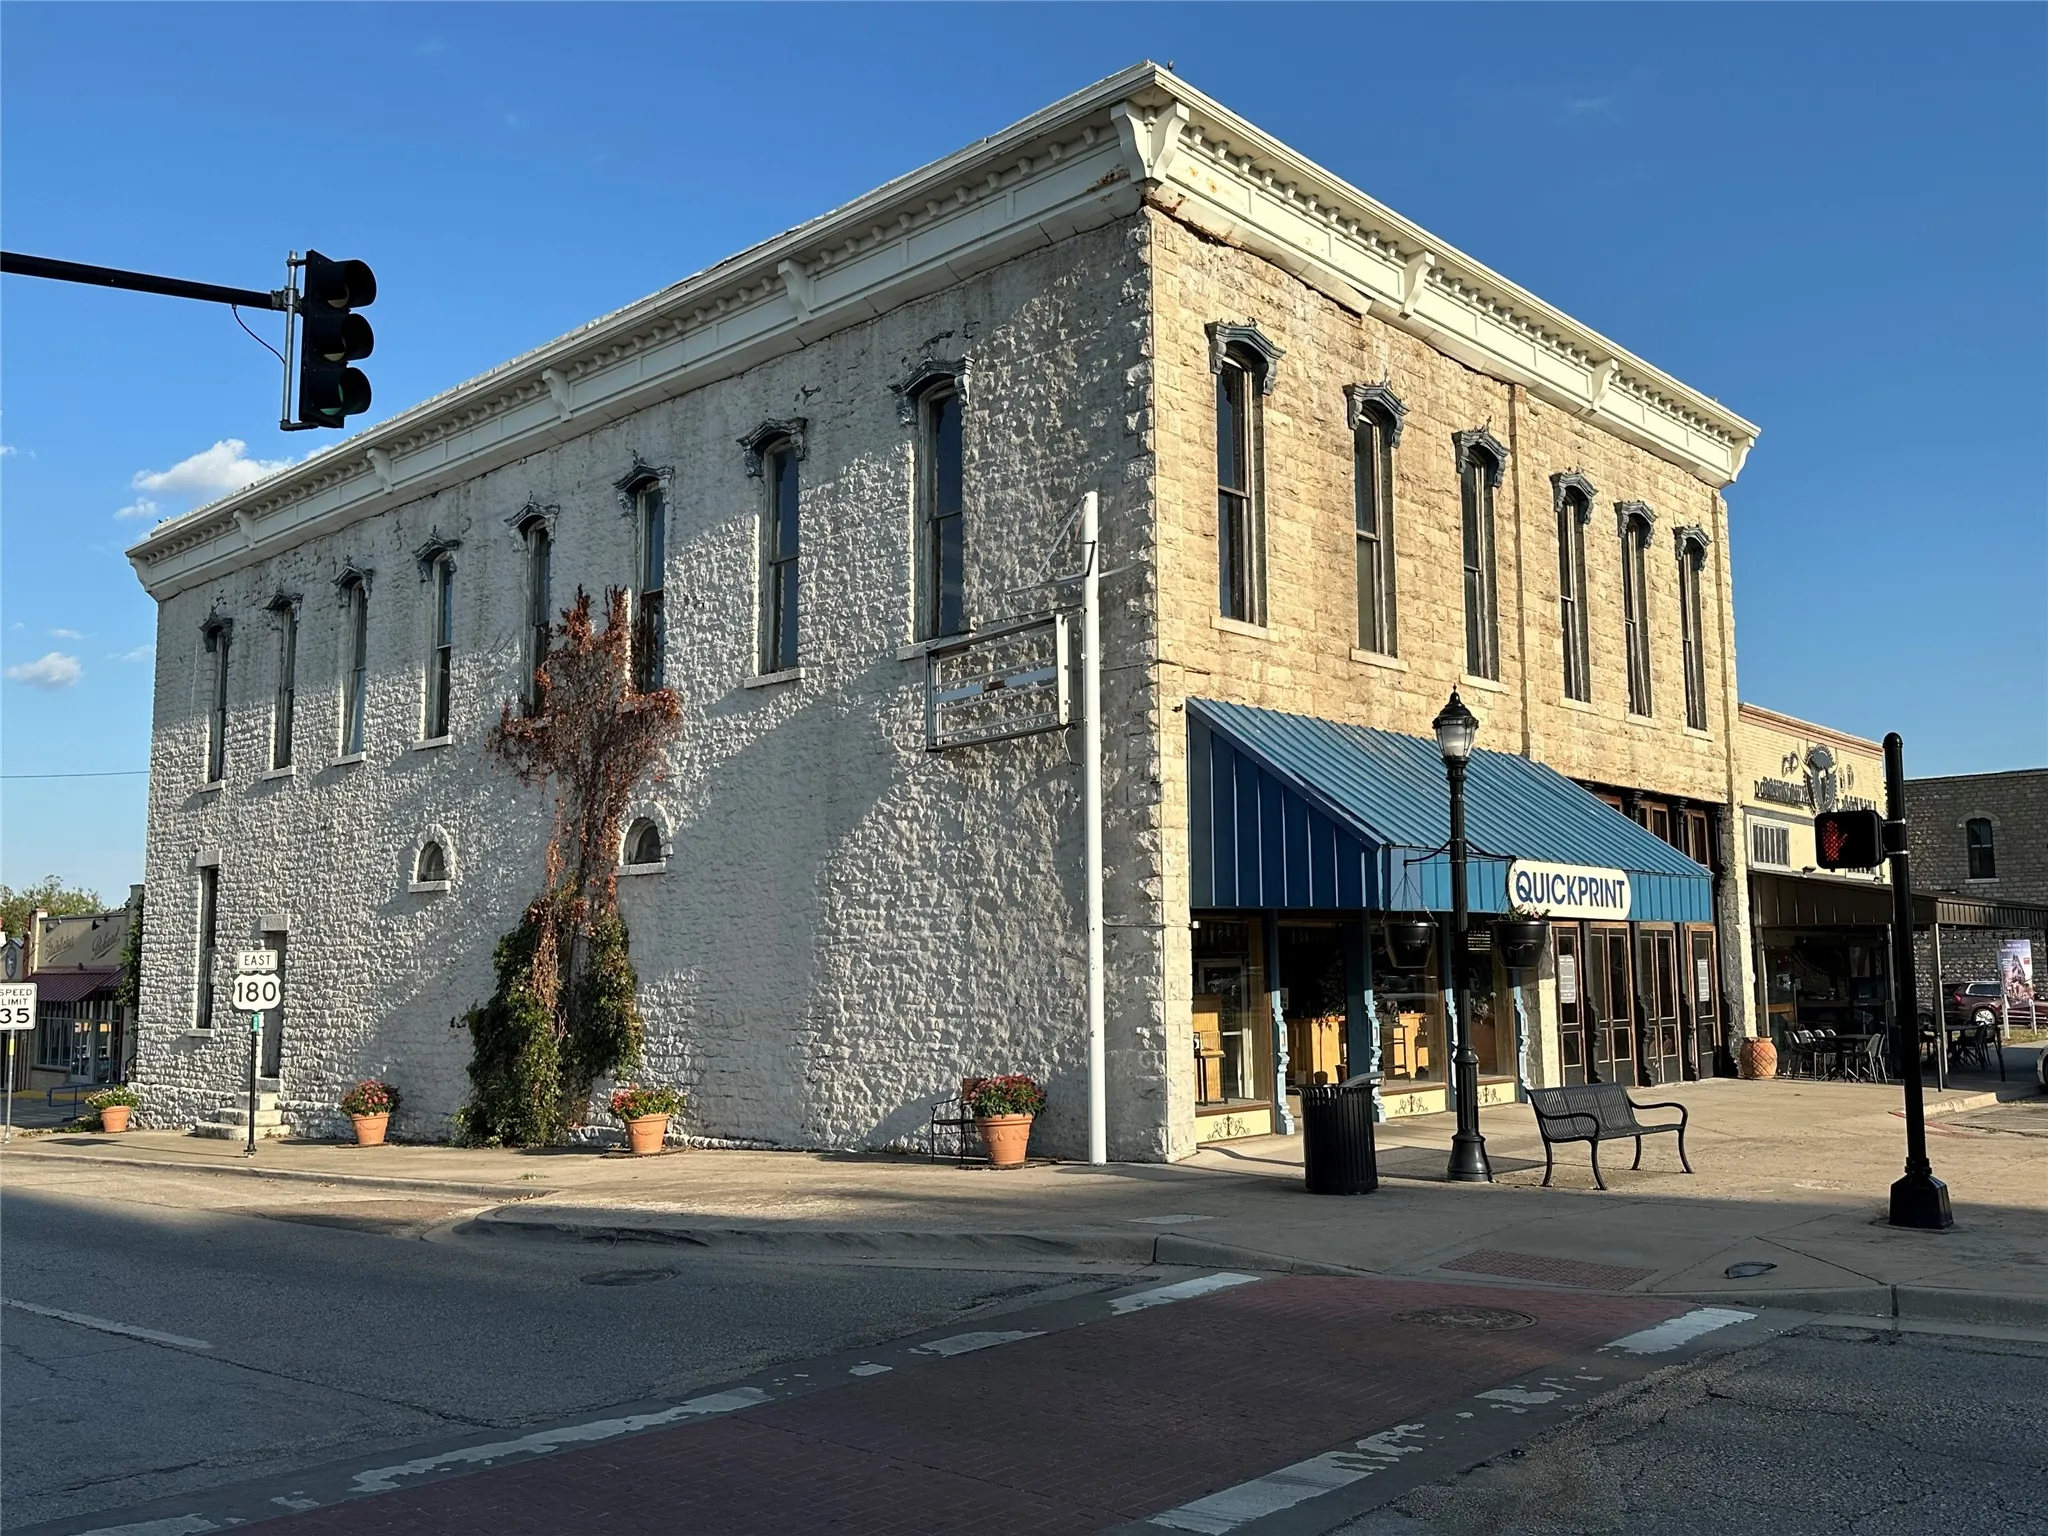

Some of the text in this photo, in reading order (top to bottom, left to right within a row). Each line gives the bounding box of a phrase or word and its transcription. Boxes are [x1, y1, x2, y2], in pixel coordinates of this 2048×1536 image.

[1515, 870, 1625, 909] QUICKPRINT
[244, 954, 272, 966] EAST
[0, 988, 33, 996] SPEED
[237, 981, 277, 1002] 180
[1, 998, 28, 1006] LIMIT
[0, 1008, 30, 1024] 35
